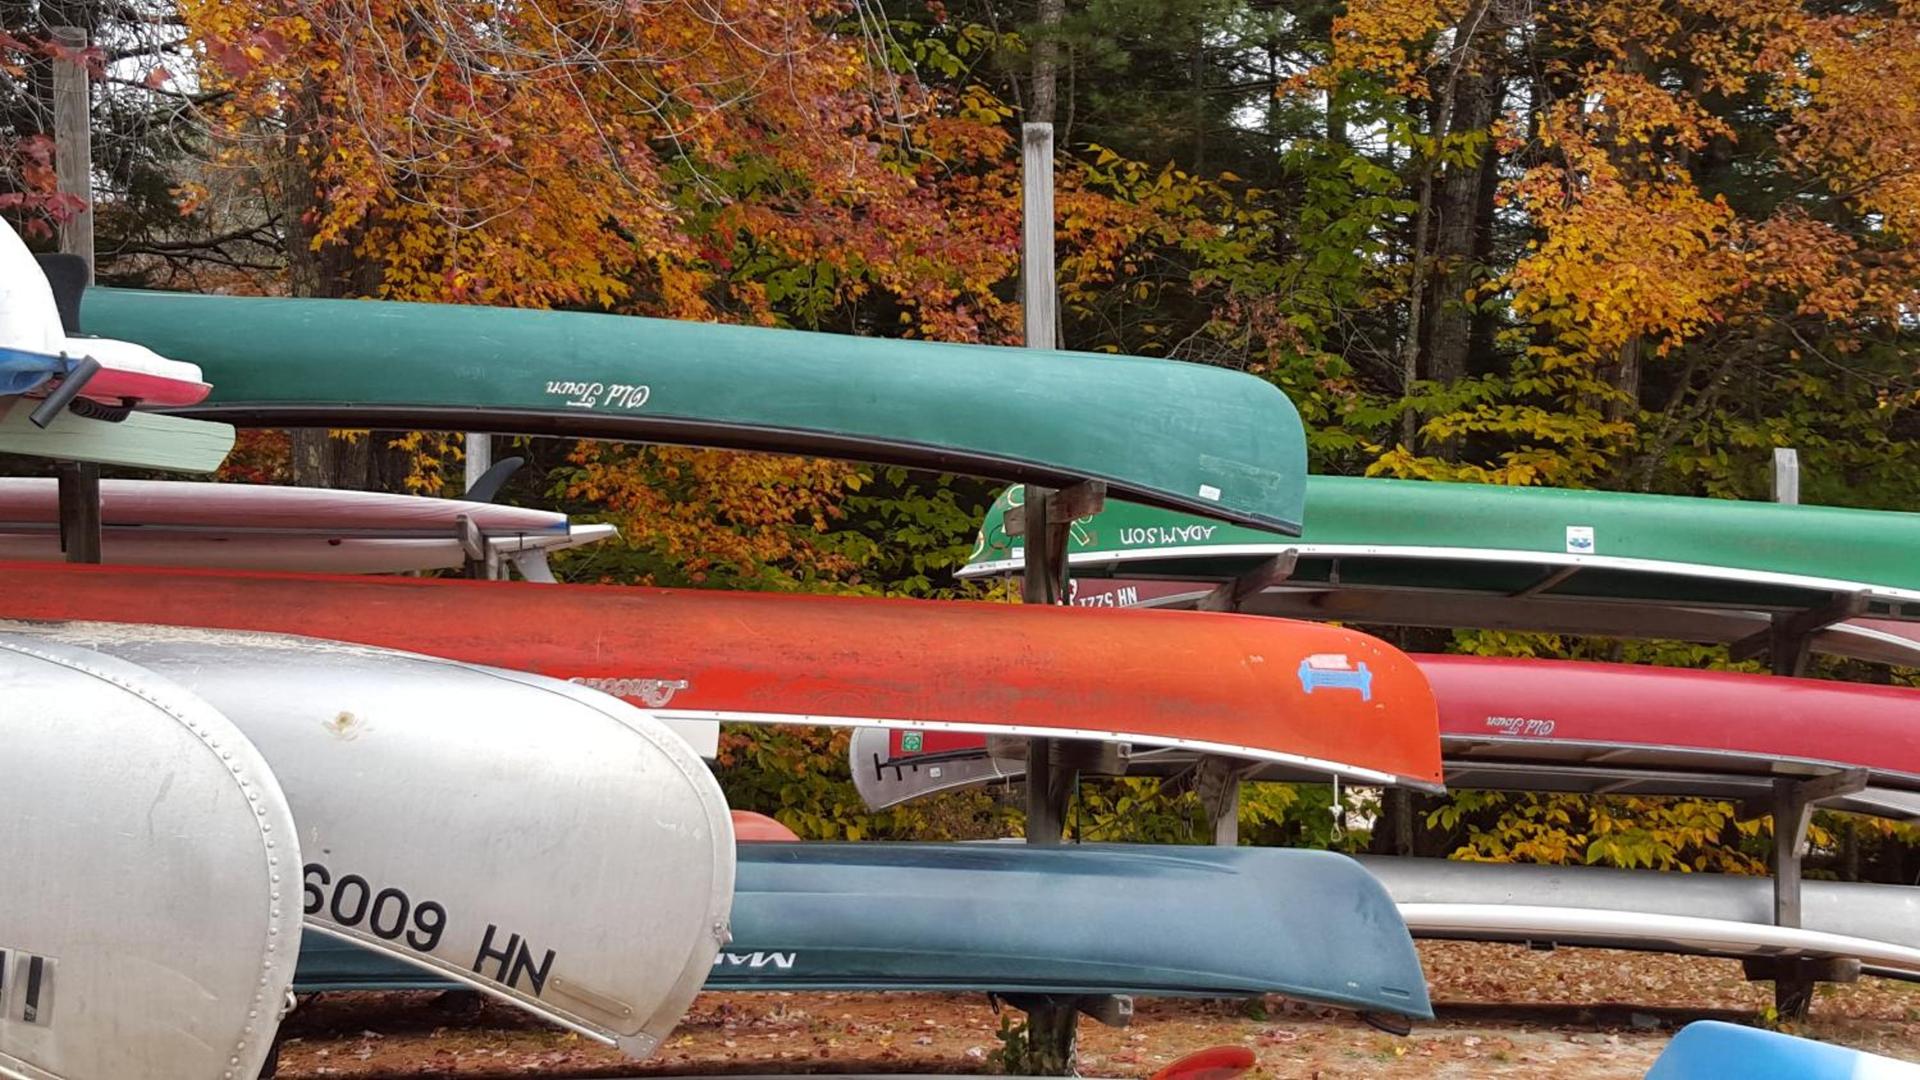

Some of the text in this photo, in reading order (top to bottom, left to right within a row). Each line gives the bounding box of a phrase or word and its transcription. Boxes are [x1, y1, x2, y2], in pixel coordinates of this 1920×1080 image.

[546, 381, 650, 408] Old Town
[1117, 586, 1138, 607] NH
[1487, 717, 1555, 736] Old Town
[473, 924, 556, 997] NH
